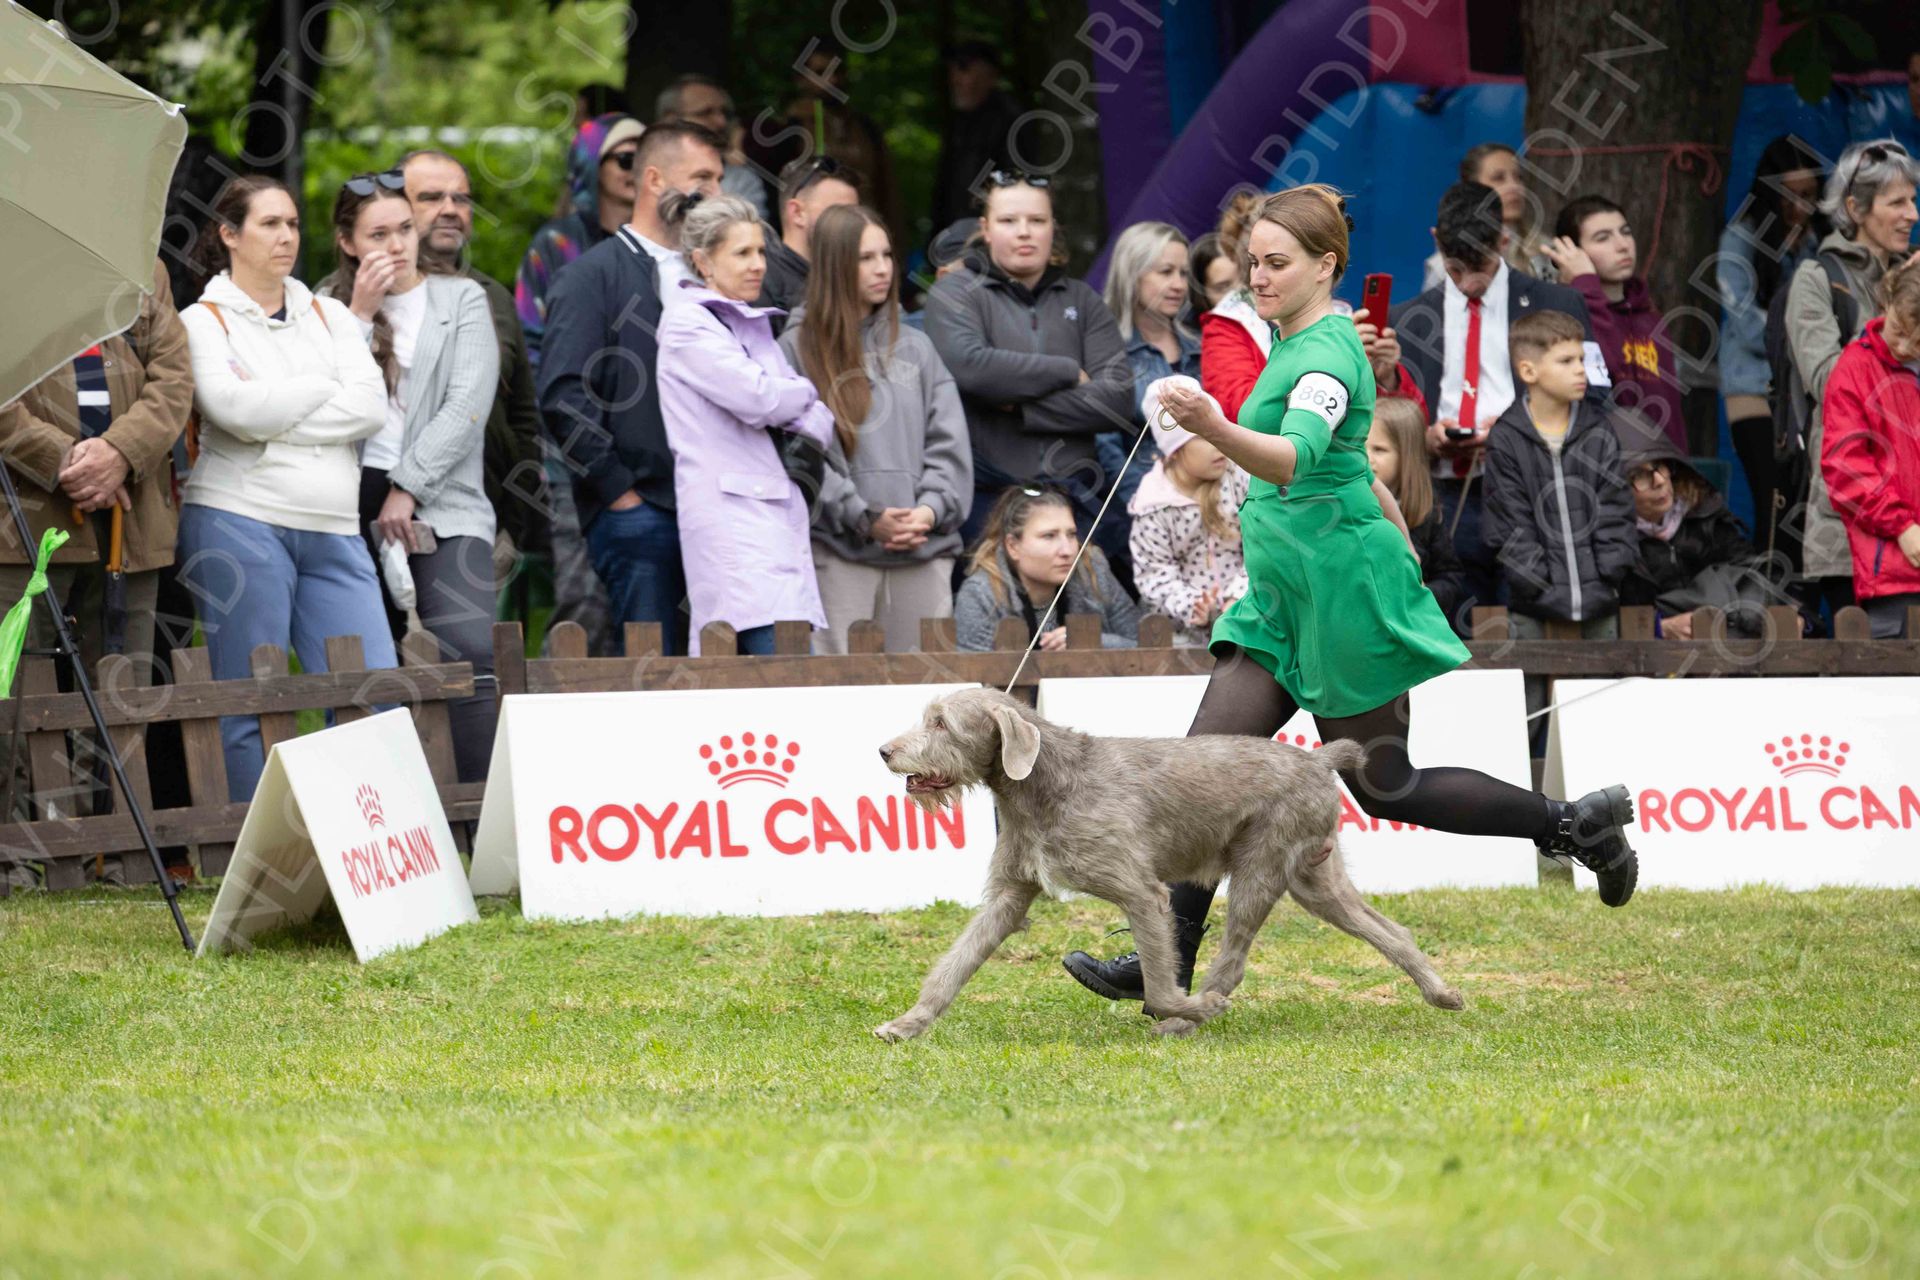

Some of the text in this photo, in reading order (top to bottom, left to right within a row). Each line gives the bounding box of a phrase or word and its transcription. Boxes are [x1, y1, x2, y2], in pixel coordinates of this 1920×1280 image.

[1298, 385, 1338, 416] 862
[549, 794, 966, 864] ROYAL CANIN
[1638, 786, 1807, 833] ROYAL
[342, 825, 440, 899] ROYAL CANIN
